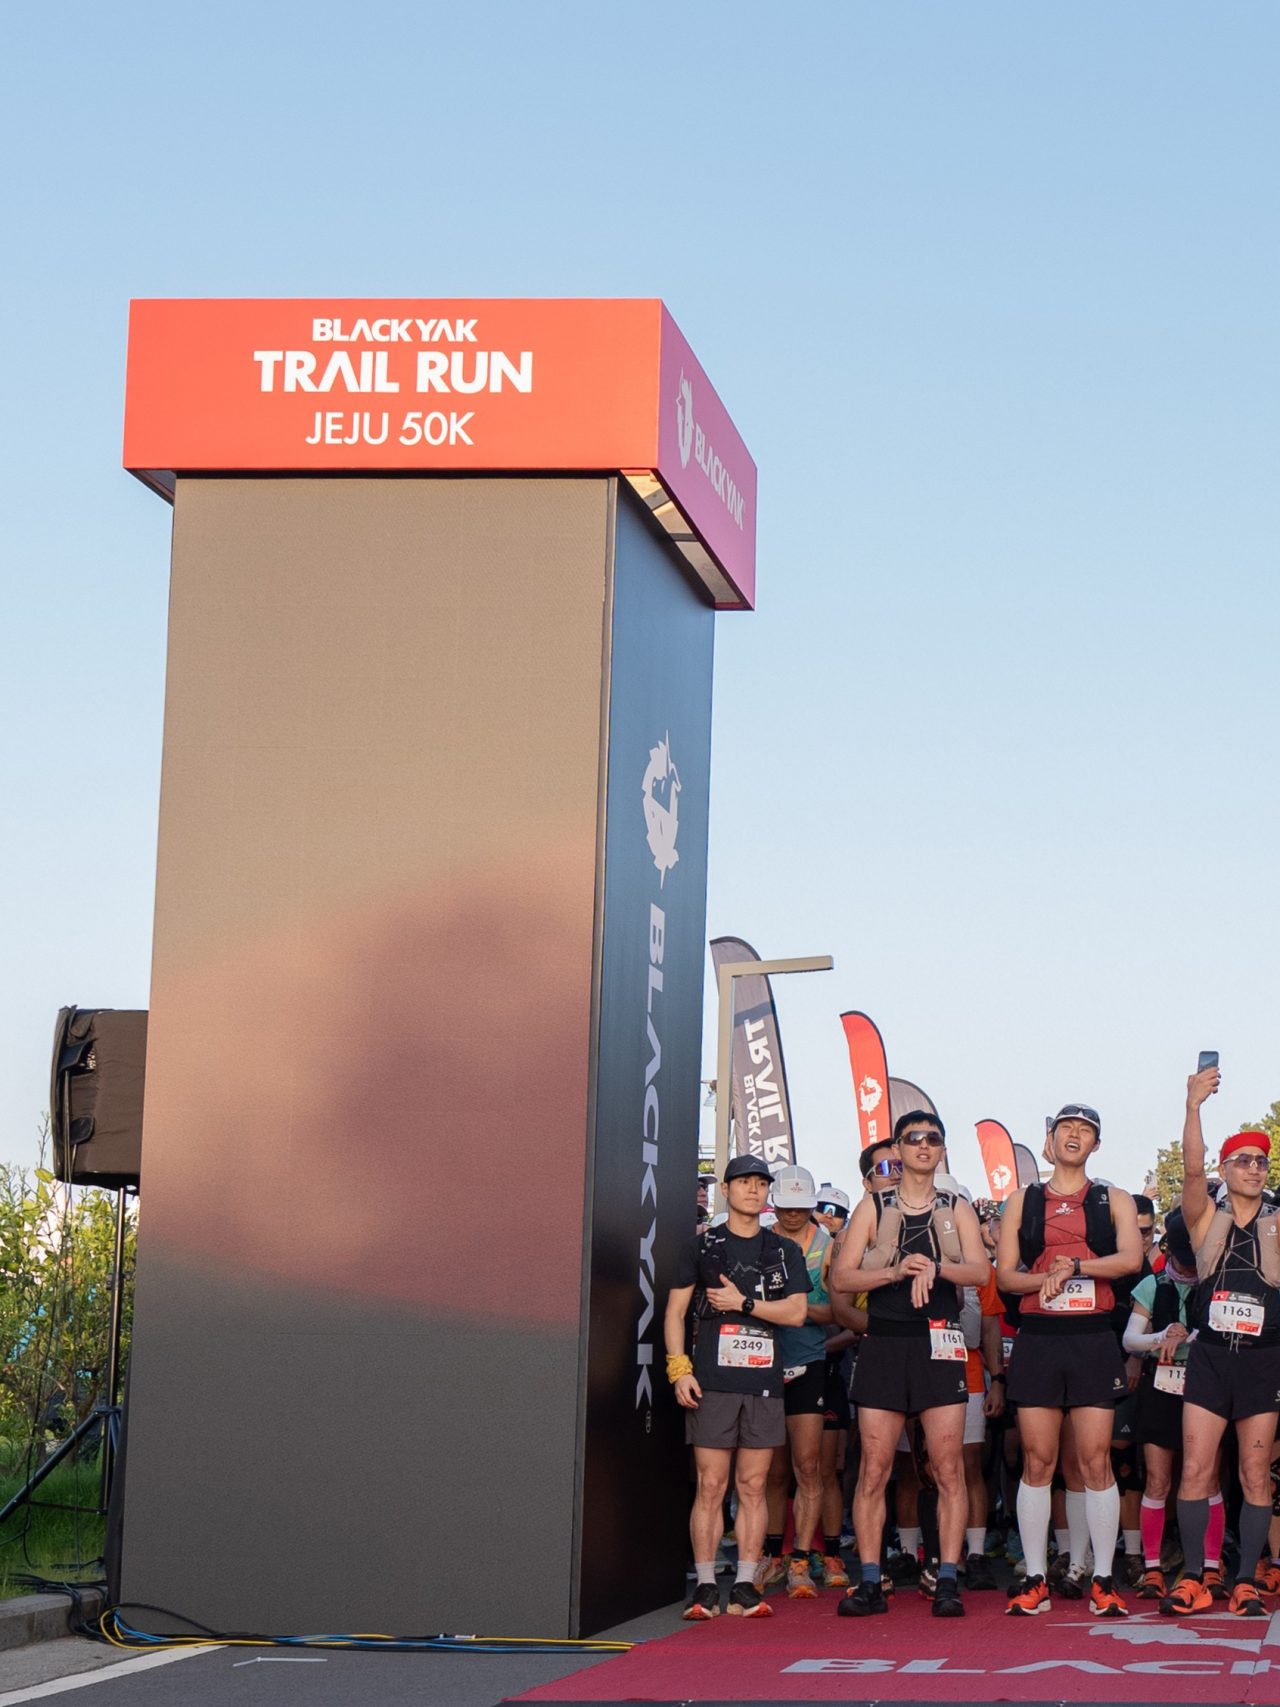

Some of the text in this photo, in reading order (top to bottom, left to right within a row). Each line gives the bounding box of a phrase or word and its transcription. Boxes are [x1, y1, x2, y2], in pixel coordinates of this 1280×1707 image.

[254, 350, 533, 394] TRAIL RUN
[305, 411, 475, 445] JEJU 50K
[1222, 1304, 1253, 1319] 1163
[732, 1338, 763, 1352] 2349
